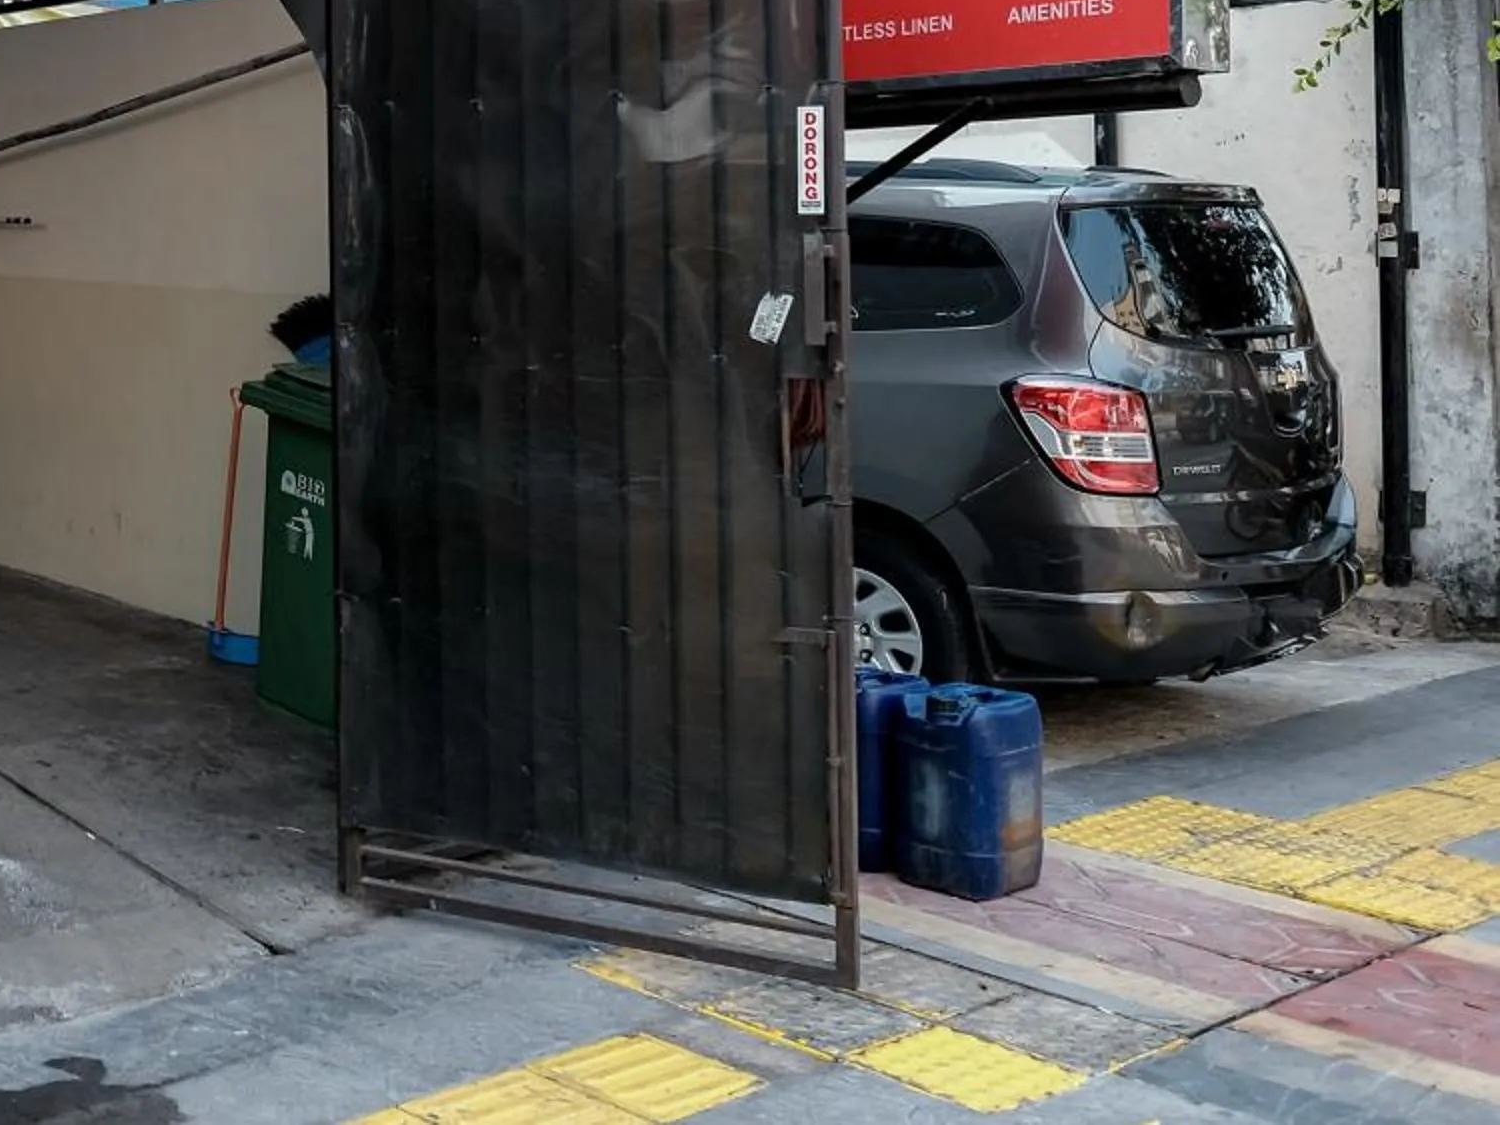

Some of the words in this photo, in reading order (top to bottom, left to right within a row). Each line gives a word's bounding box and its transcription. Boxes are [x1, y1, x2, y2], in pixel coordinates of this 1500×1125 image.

[842, 20, 896, 42] TLESS
[901, 14, 952, 36] LINEN
[803, 111, 817, 200] DORONG
